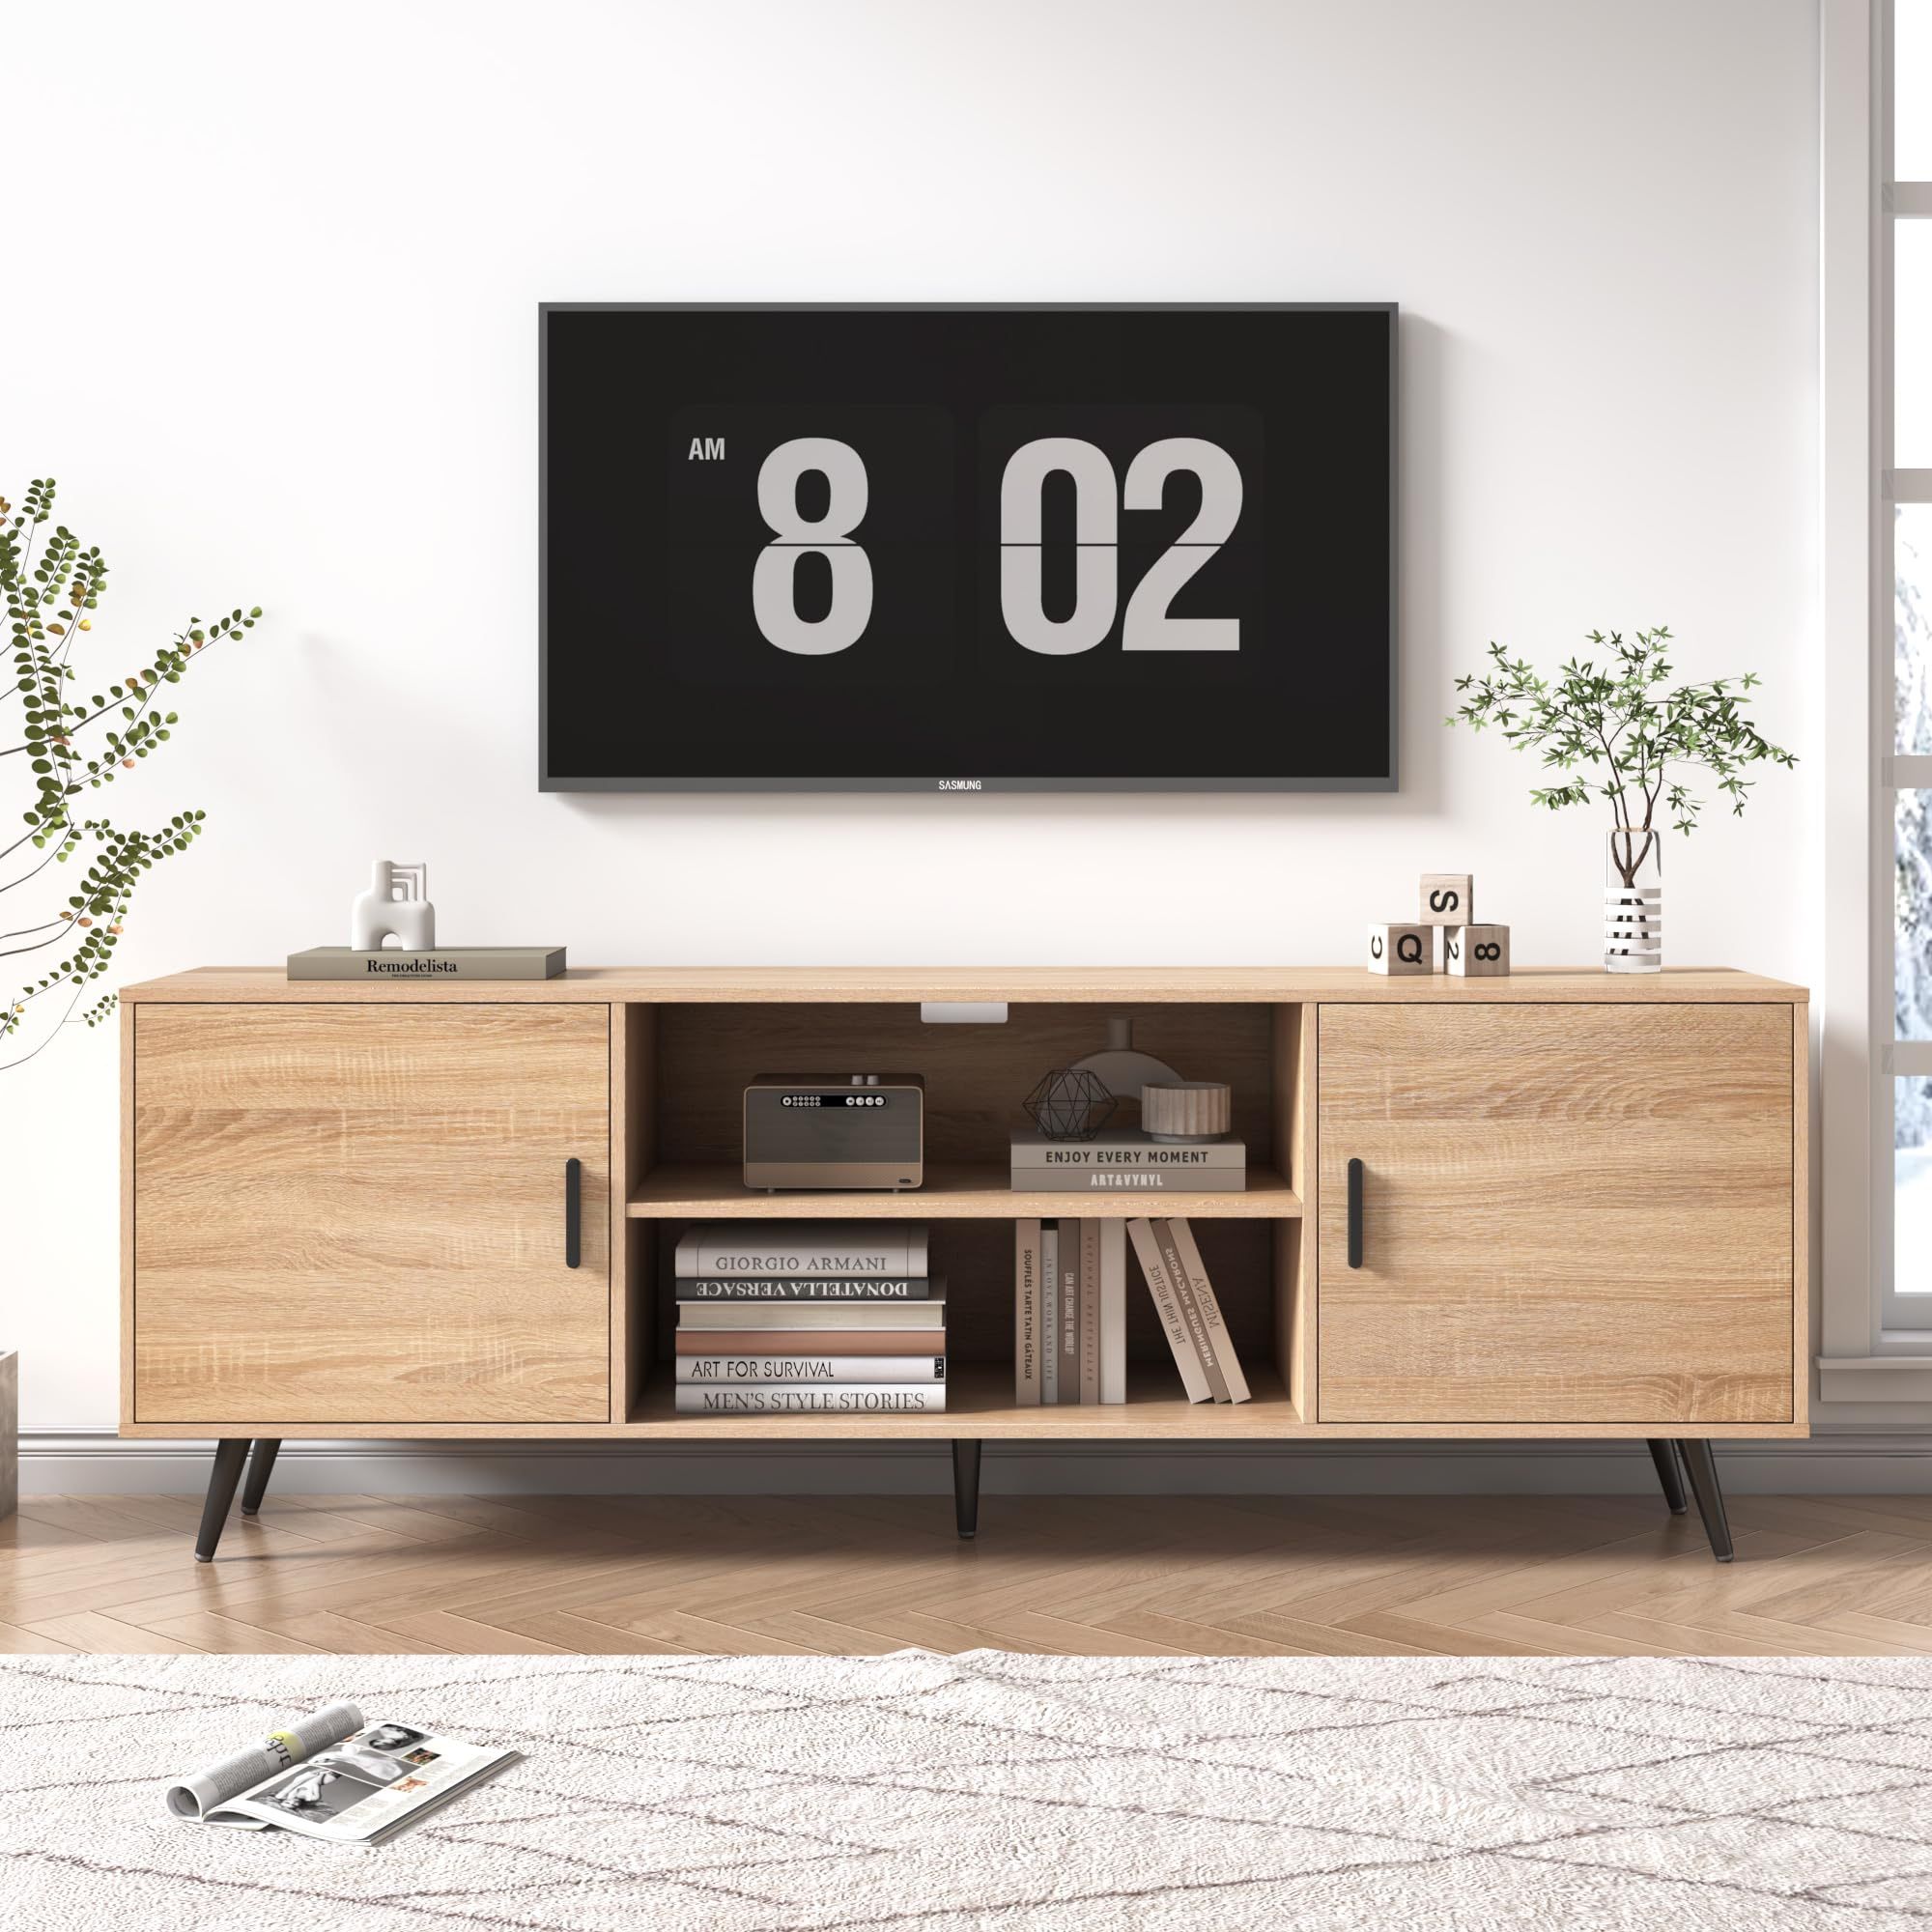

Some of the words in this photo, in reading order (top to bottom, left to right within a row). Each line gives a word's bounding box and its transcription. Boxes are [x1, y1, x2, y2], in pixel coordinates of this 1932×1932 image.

[688, 438, 725, 460] AM
[753, 438, 873, 655] 8
[1001, 438, 1243, 655] 02
[938, 780, 982, 790] SASMUNG
[1429, 890, 1459, 913] S
[1397, 933, 1423, 965] Q
[1474, 943, 1501, 961] 8
[367, 958, 457, 973] Remodelista
[1046, 1151, 1091, 1163] ENJOY
[1096, 1151, 1142, 1163] EVERY
[1148, 1151, 1208, 1163] MOMENT
[716, 1257, 799, 1270] GIORGIO
[807, 1257, 886, 1270] ARMANI
[1065, 1272, 1075, 1285] CAN
[696, 1282, 785, 1296] VERSACE
[790, 1282, 908, 1296] DONATELLA
[691, 1361, 721, 1378] ART
[727, 1361, 758, 1378] FOR
[763, 1361, 835, 1378] SURVIVAL
[771, 1392, 836, 1409] STYLE
[838, 1392, 924, 1409] STORIES
